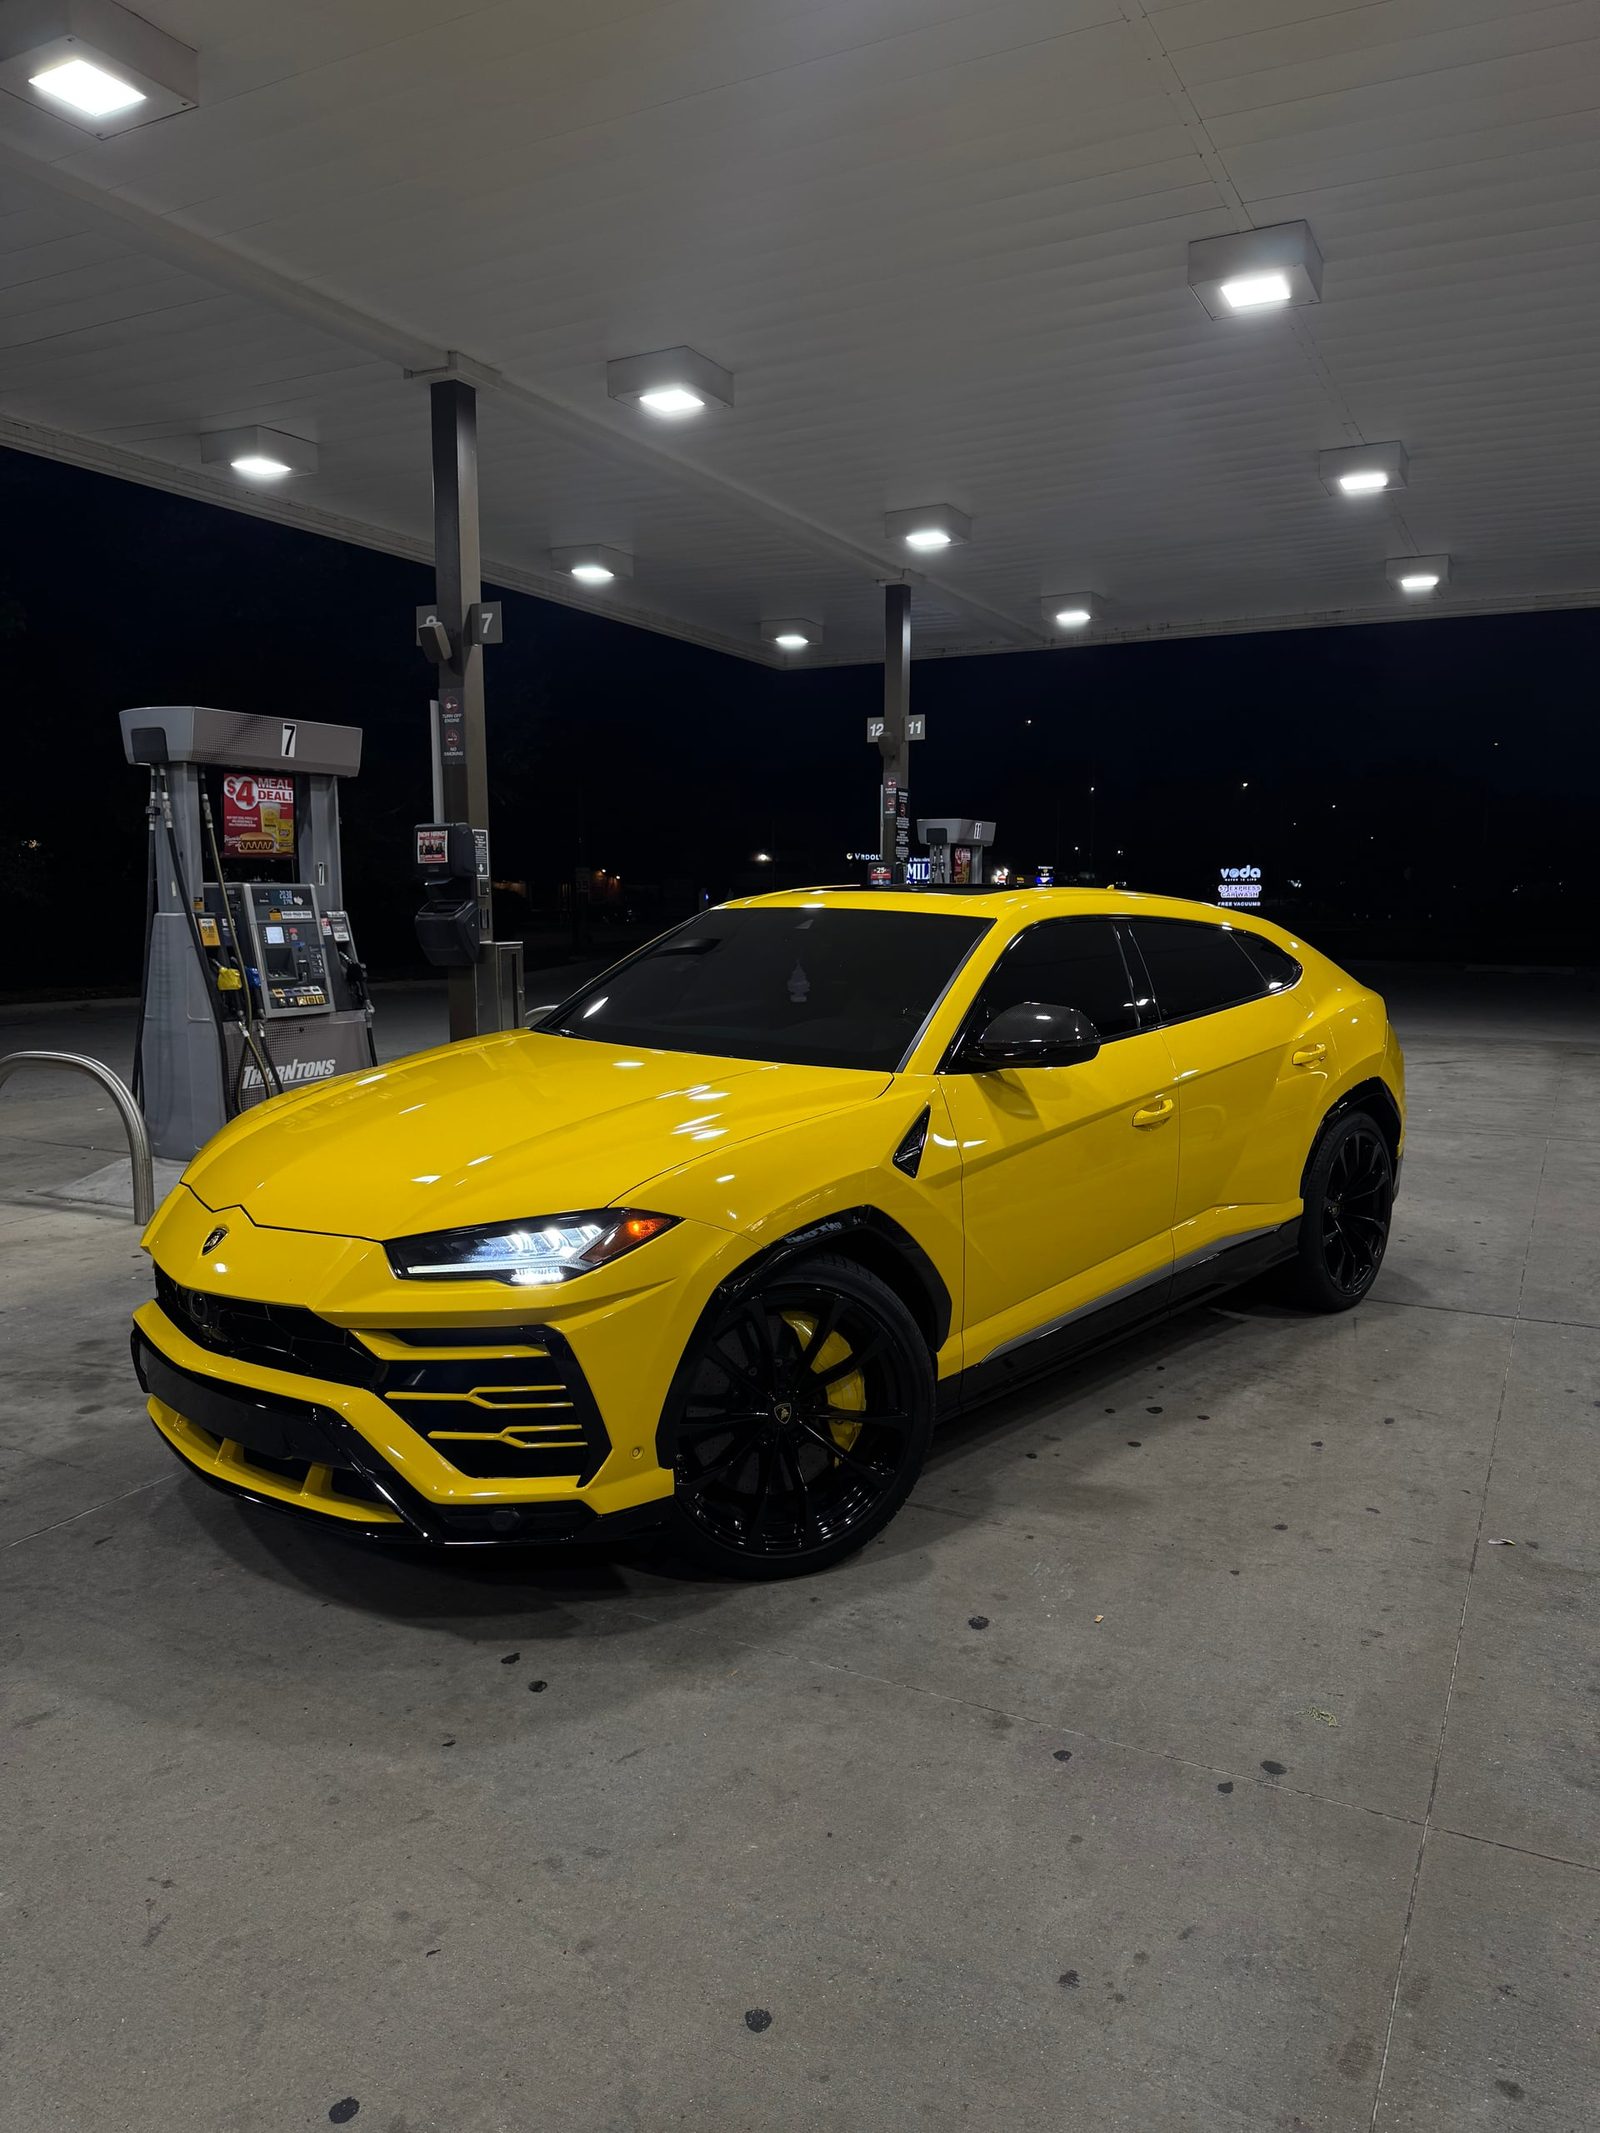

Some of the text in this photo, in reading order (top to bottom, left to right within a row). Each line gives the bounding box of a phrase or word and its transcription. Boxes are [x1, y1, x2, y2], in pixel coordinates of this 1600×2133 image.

[481, 613, 493, 634] 7
[870, 723, 884, 737] 12
[908, 721, 922, 735] 11
[284, 725, 295, 755] 7
[226, 777, 293, 806] $4 MEAL
[258, 790, 292, 802] DEAL!
[854, 853, 881, 861] VRDOL
[906, 863, 930, 880] MIL
[1220, 864, 1261, 878] voda
